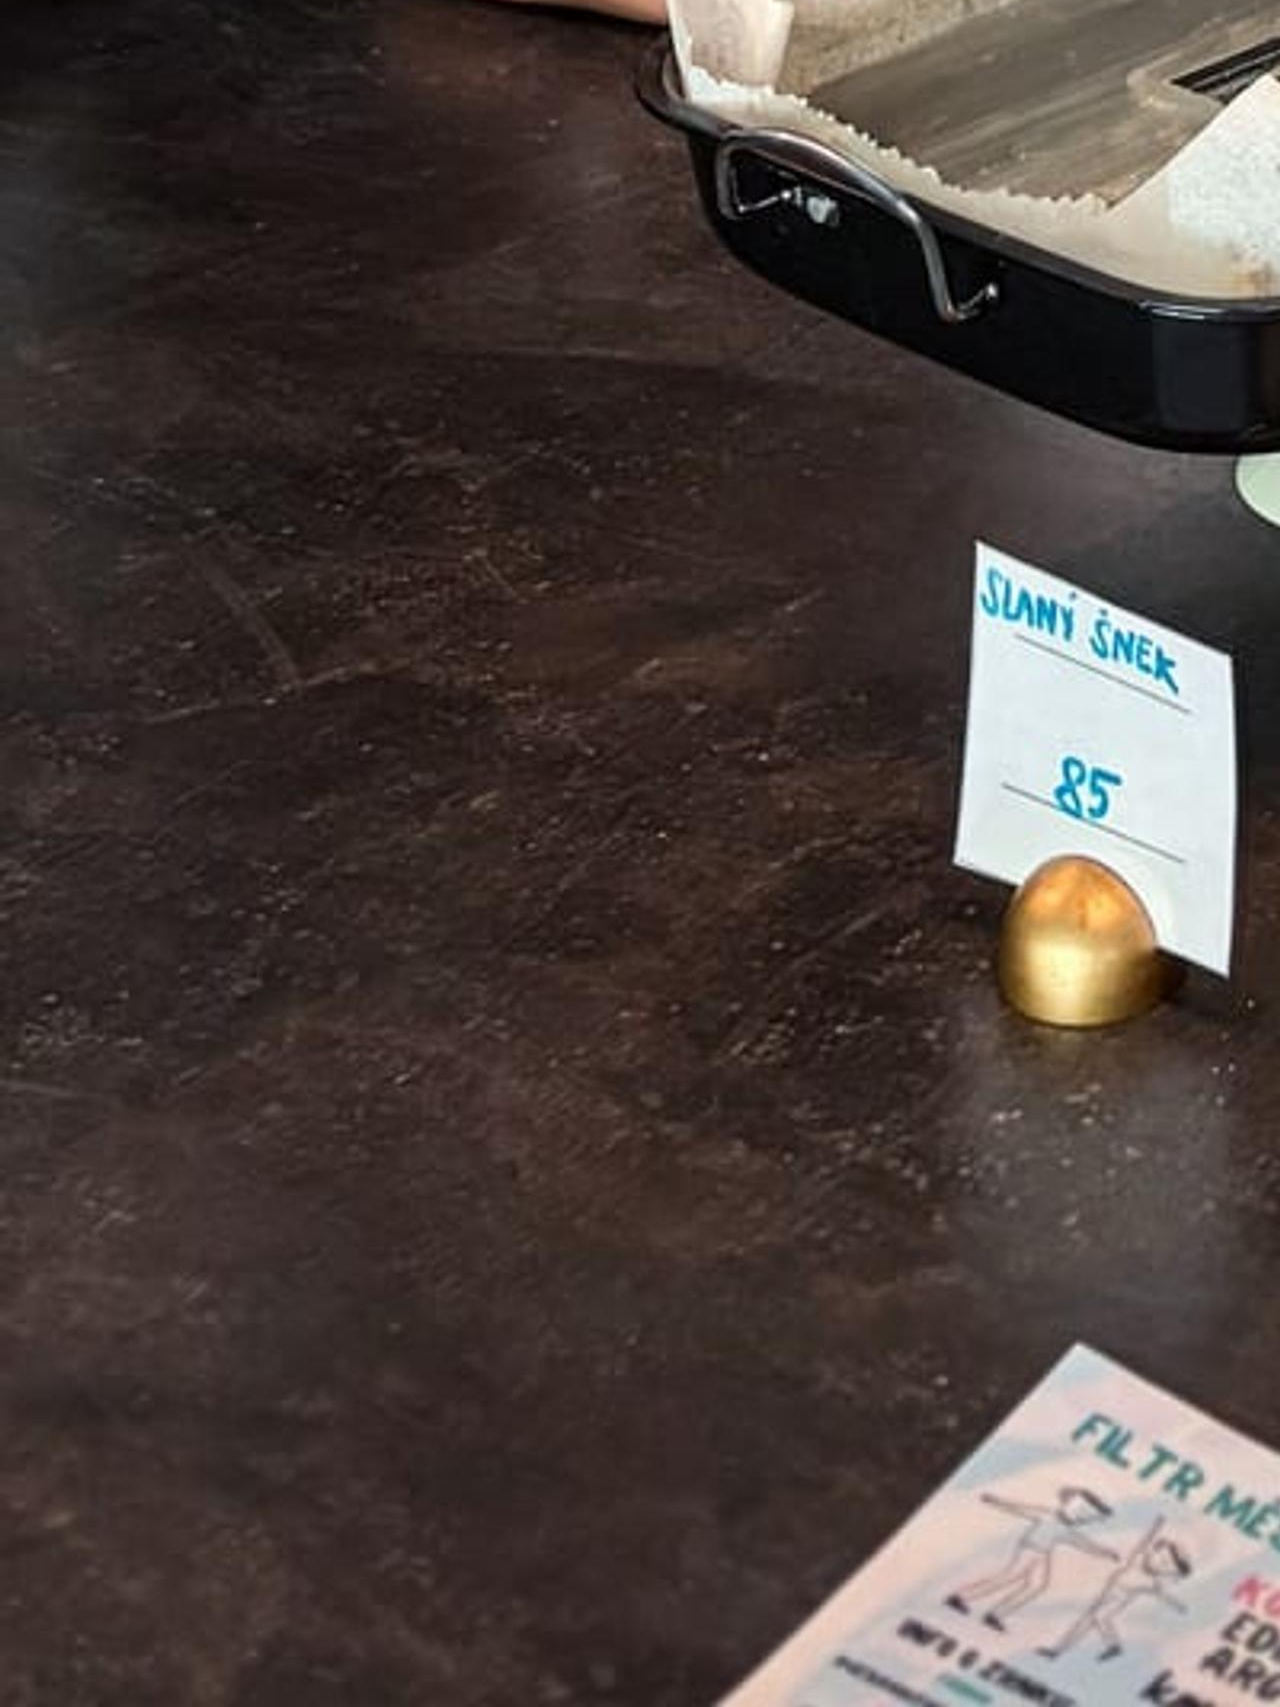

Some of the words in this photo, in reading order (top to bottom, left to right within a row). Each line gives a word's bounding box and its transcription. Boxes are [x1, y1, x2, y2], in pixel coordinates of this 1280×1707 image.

[979, 567, 1075, 641] SLANÝ
[1089, 608, 1180, 695] ŠNEK
[1052, 755, 1122, 820] 85
[1071, 1412, 1205, 1501] FILTR
